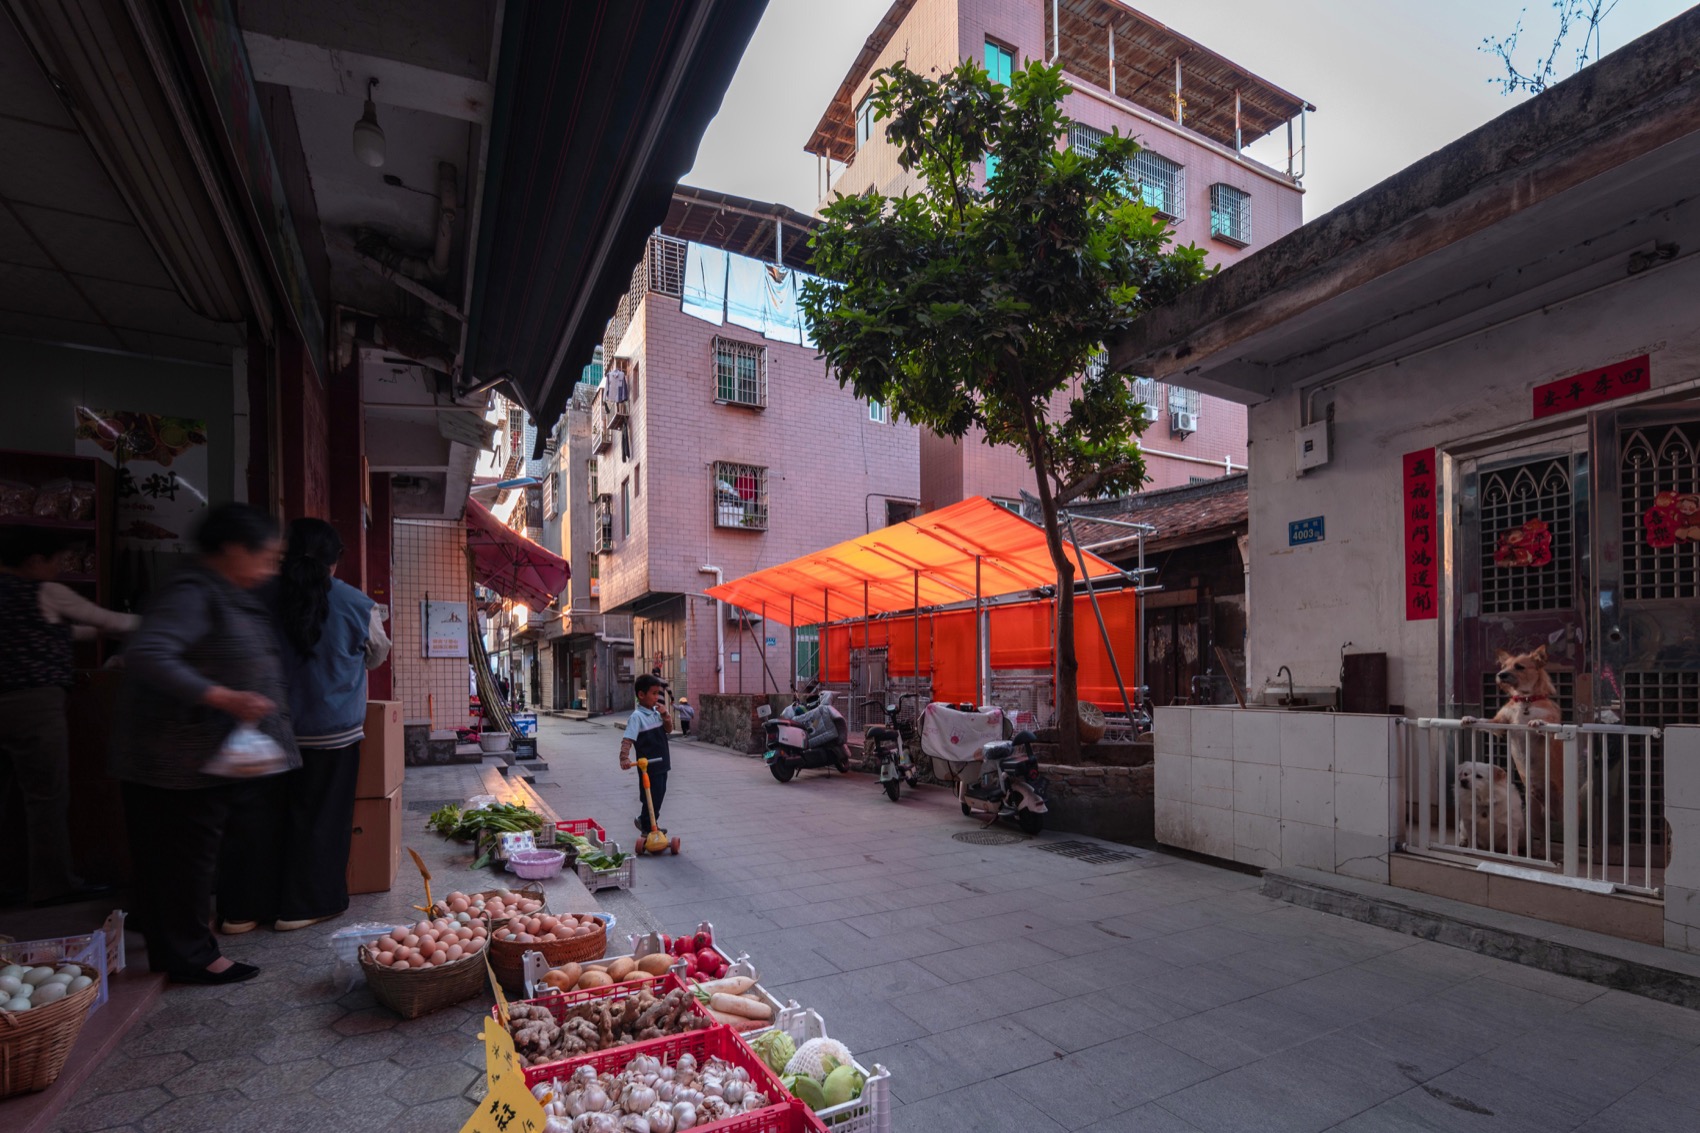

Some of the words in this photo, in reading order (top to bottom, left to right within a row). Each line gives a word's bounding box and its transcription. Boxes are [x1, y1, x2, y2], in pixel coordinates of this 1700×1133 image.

[1543, 367, 1645, 409] 四季平安
[1293, 529, 1314, 540] 4003
